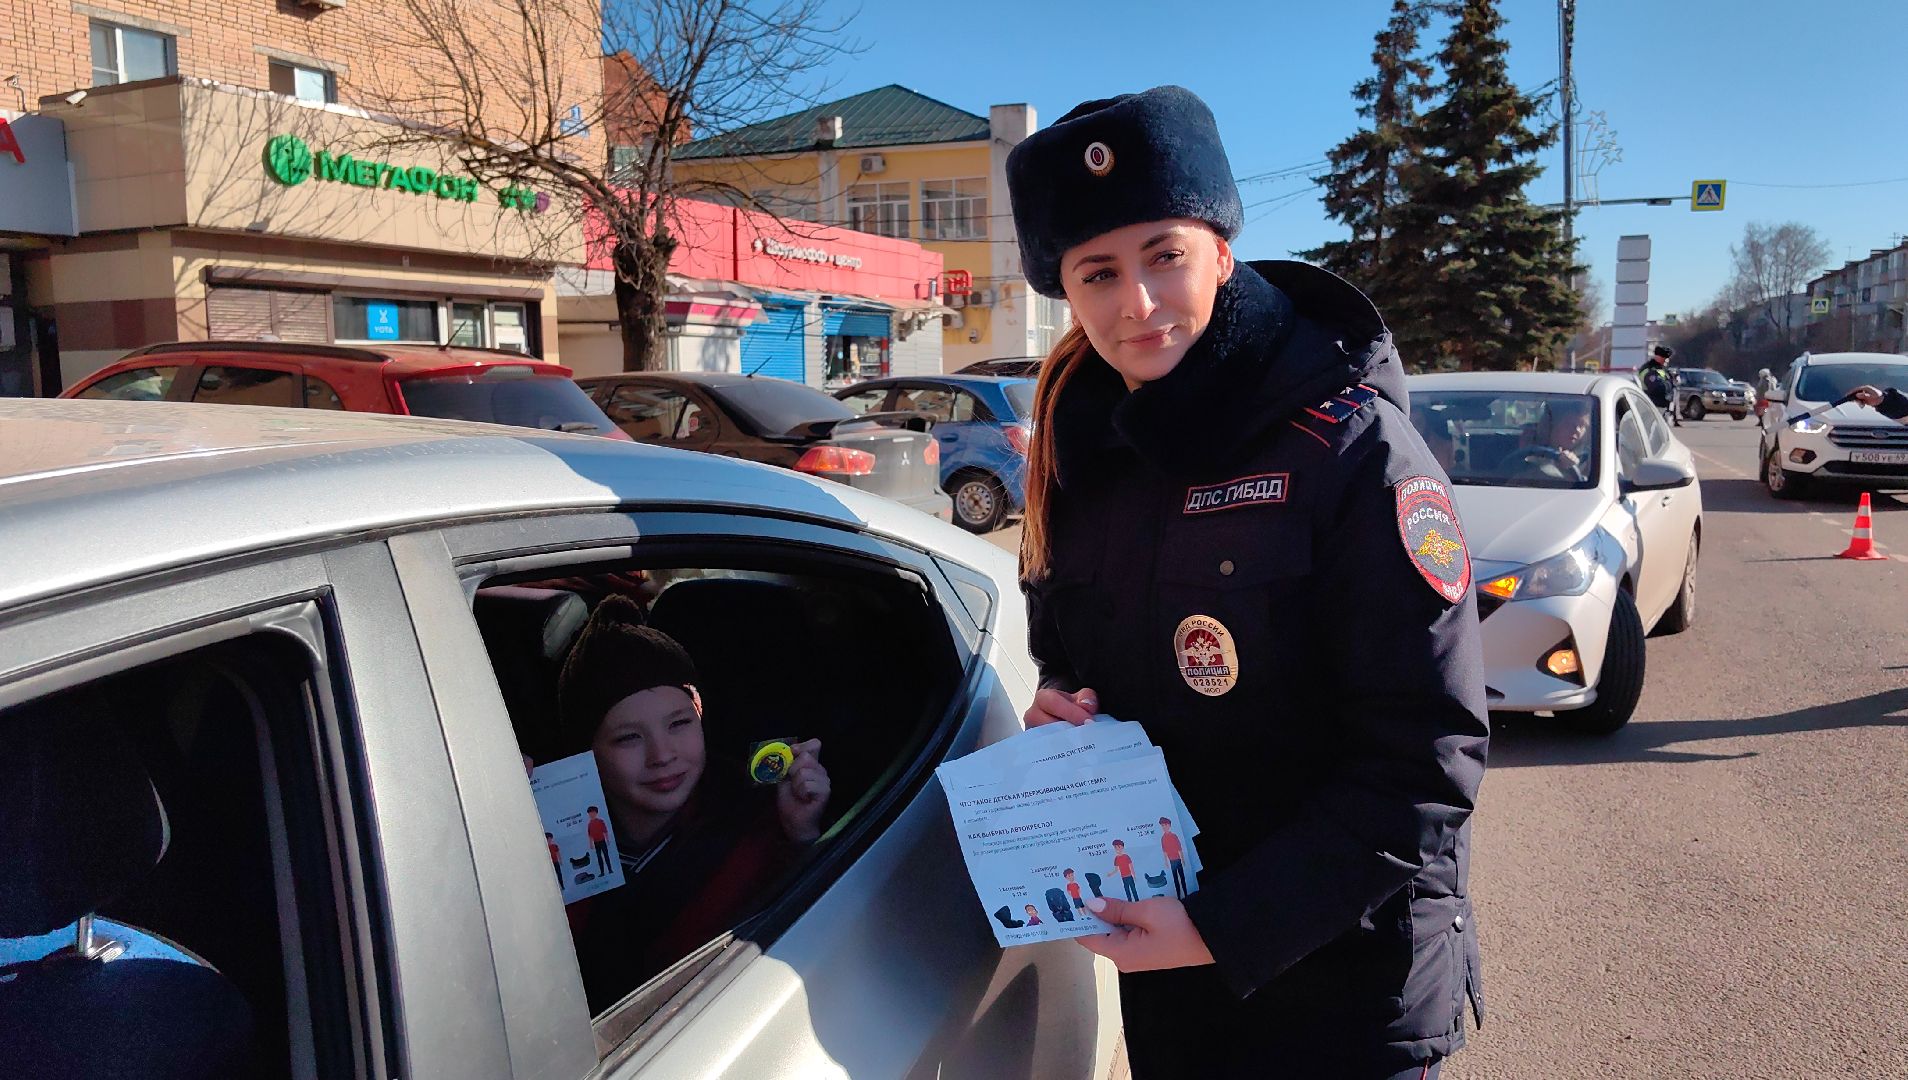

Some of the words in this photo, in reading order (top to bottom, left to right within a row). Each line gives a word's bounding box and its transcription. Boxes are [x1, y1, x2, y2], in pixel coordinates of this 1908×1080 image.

[374, 325, 394, 335] YOTA
[1187, 489, 1223, 511] ДПС
[1224, 479, 1283, 502] ГИБДД
[1401, 479, 1447, 501] ПОЛИЦИЯ
[1407, 507, 1451, 530] РОССИЯ
[1442, 581, 1464, 600] МВД
[1191, 619, 1225, 636] РОССИИ
[1187, 665, 1229, 677] ПОЛИЦИЯ
[972, 797, 992, 806] ТАКОЕ
[992, 793, 1020, 804] ДЕТСКАЯ
[1020, 782, 1074, 799] УДЕРЖИВАЮЩАЯ
[967, 831, 982, 840] КАК
[982, 827, 1010, 838] ВЫБРАТЬ
